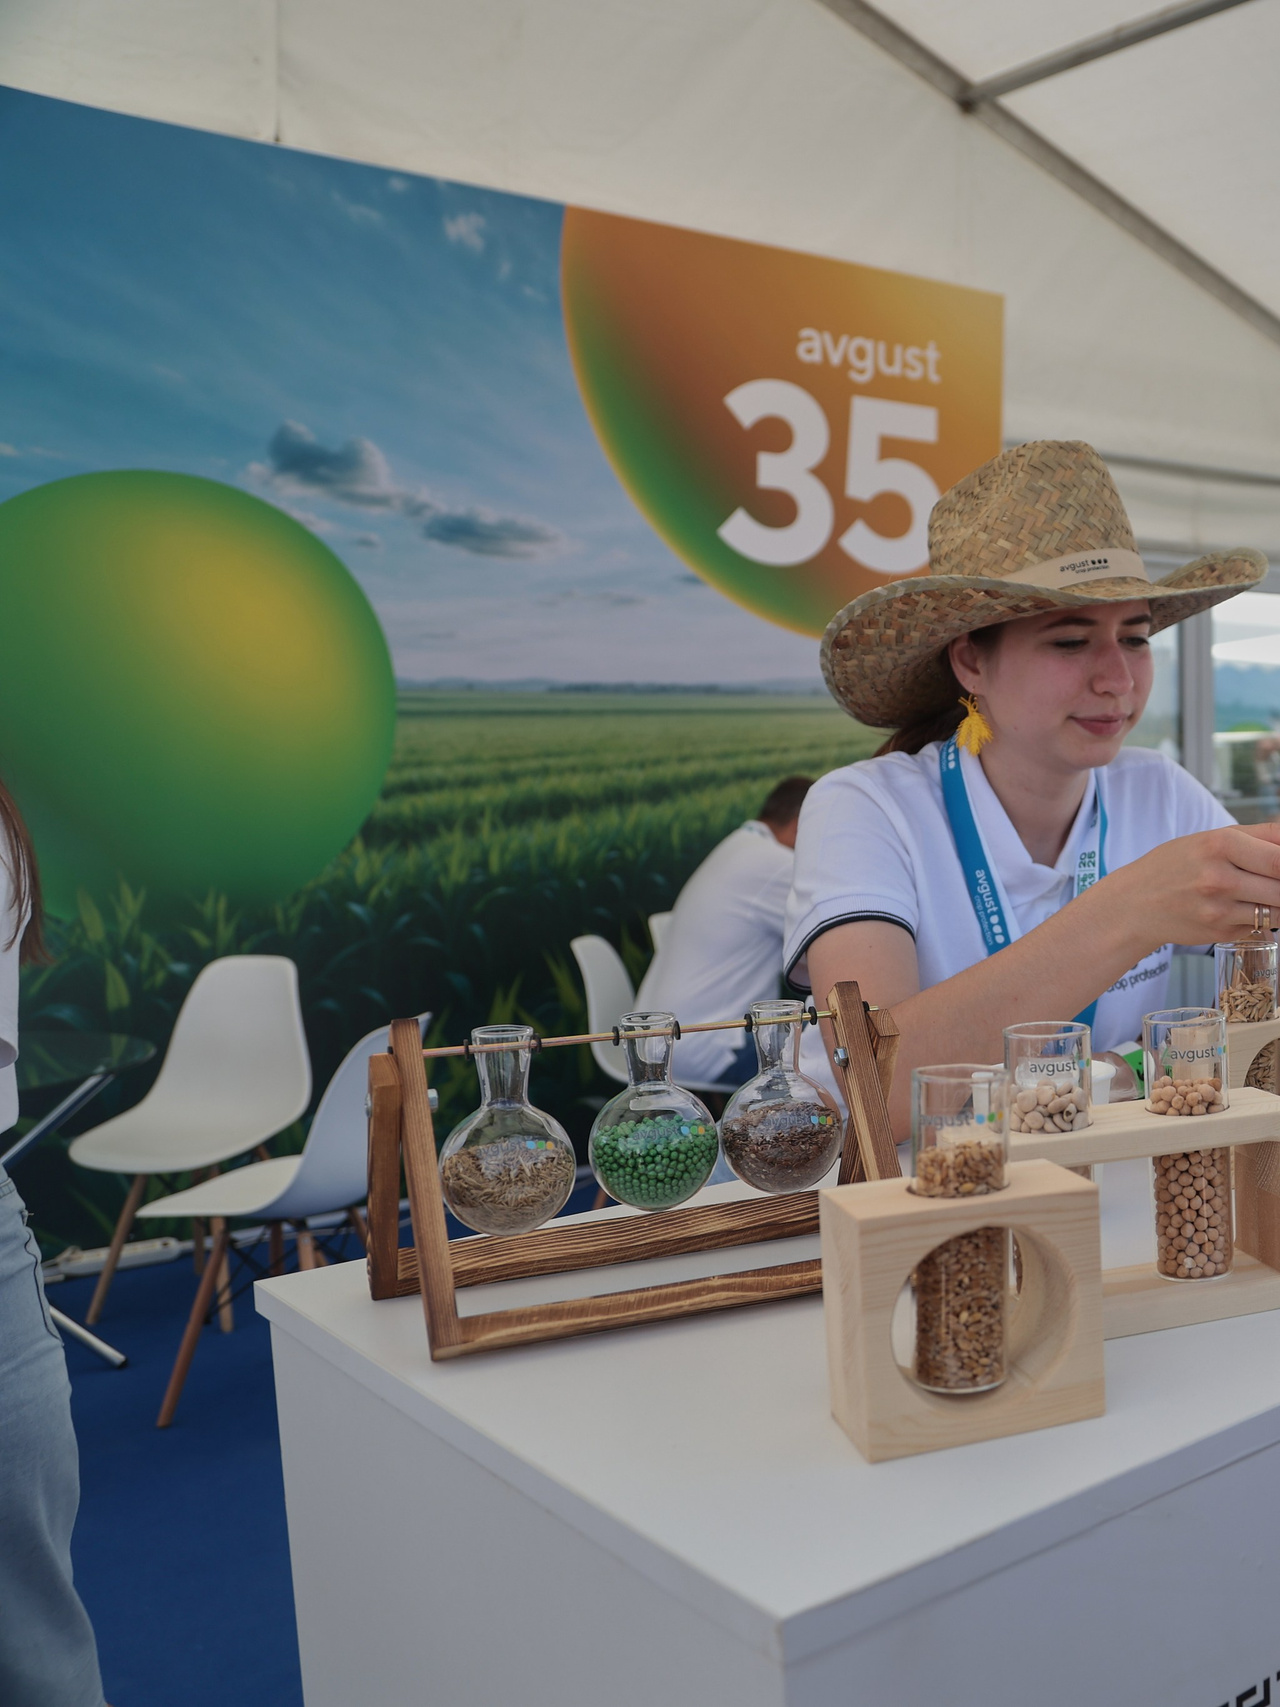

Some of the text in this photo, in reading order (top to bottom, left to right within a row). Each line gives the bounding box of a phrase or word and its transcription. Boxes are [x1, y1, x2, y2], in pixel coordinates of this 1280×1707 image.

[796, 327, 942, 384] avgust
[716, 377, 943, 575] 35
[1060, 558, 1090, 572] avgust
[975, 869, 999, 914] avgust
[1170, 1046, 1215, 1063] avgust
[1029, 1060, 1077, 1077] avgust
[919, 1112, 972, 1131] avgust
[632, 1125, 679, 1140] avgust
[476, 1139, 525, 1158] avgust
